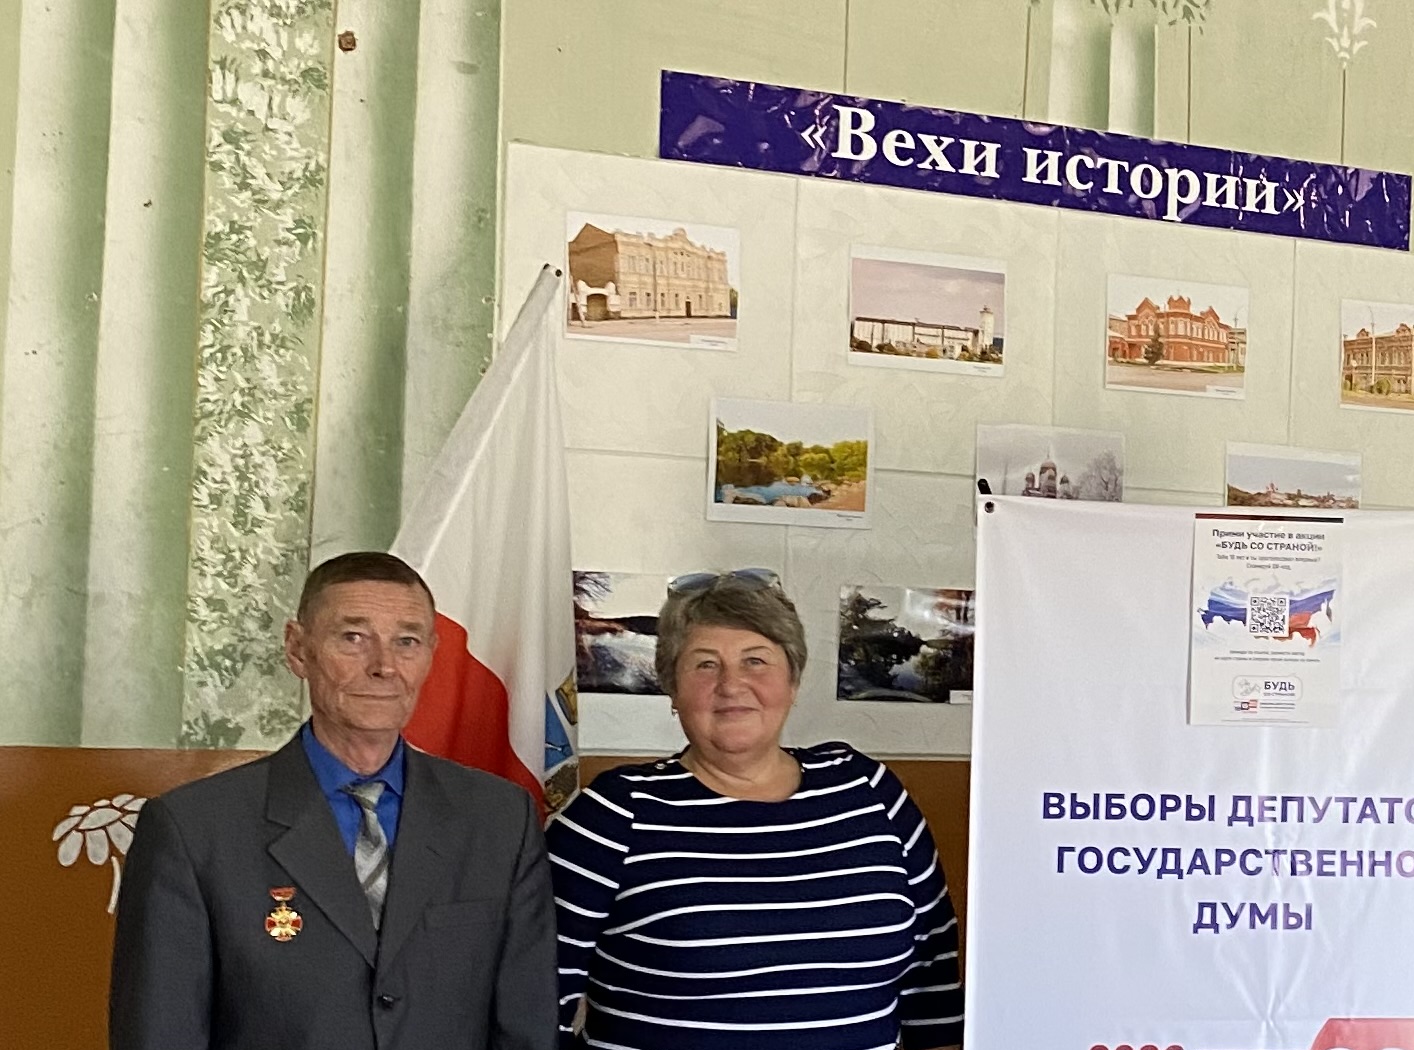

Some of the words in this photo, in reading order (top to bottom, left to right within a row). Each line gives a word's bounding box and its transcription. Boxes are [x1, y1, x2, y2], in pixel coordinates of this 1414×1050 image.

[801, 104, 1001, 179] «Вехи
[1022, 144, 1305, 222] истории»
[1250, 541, 1264, 550] СО
[1264, 681, 1295, 691] БУДЬ
[1042, 792, 1216, 822] ВЫБОРЫ
[1193, 901, 1313, 934] ДУМЫ
